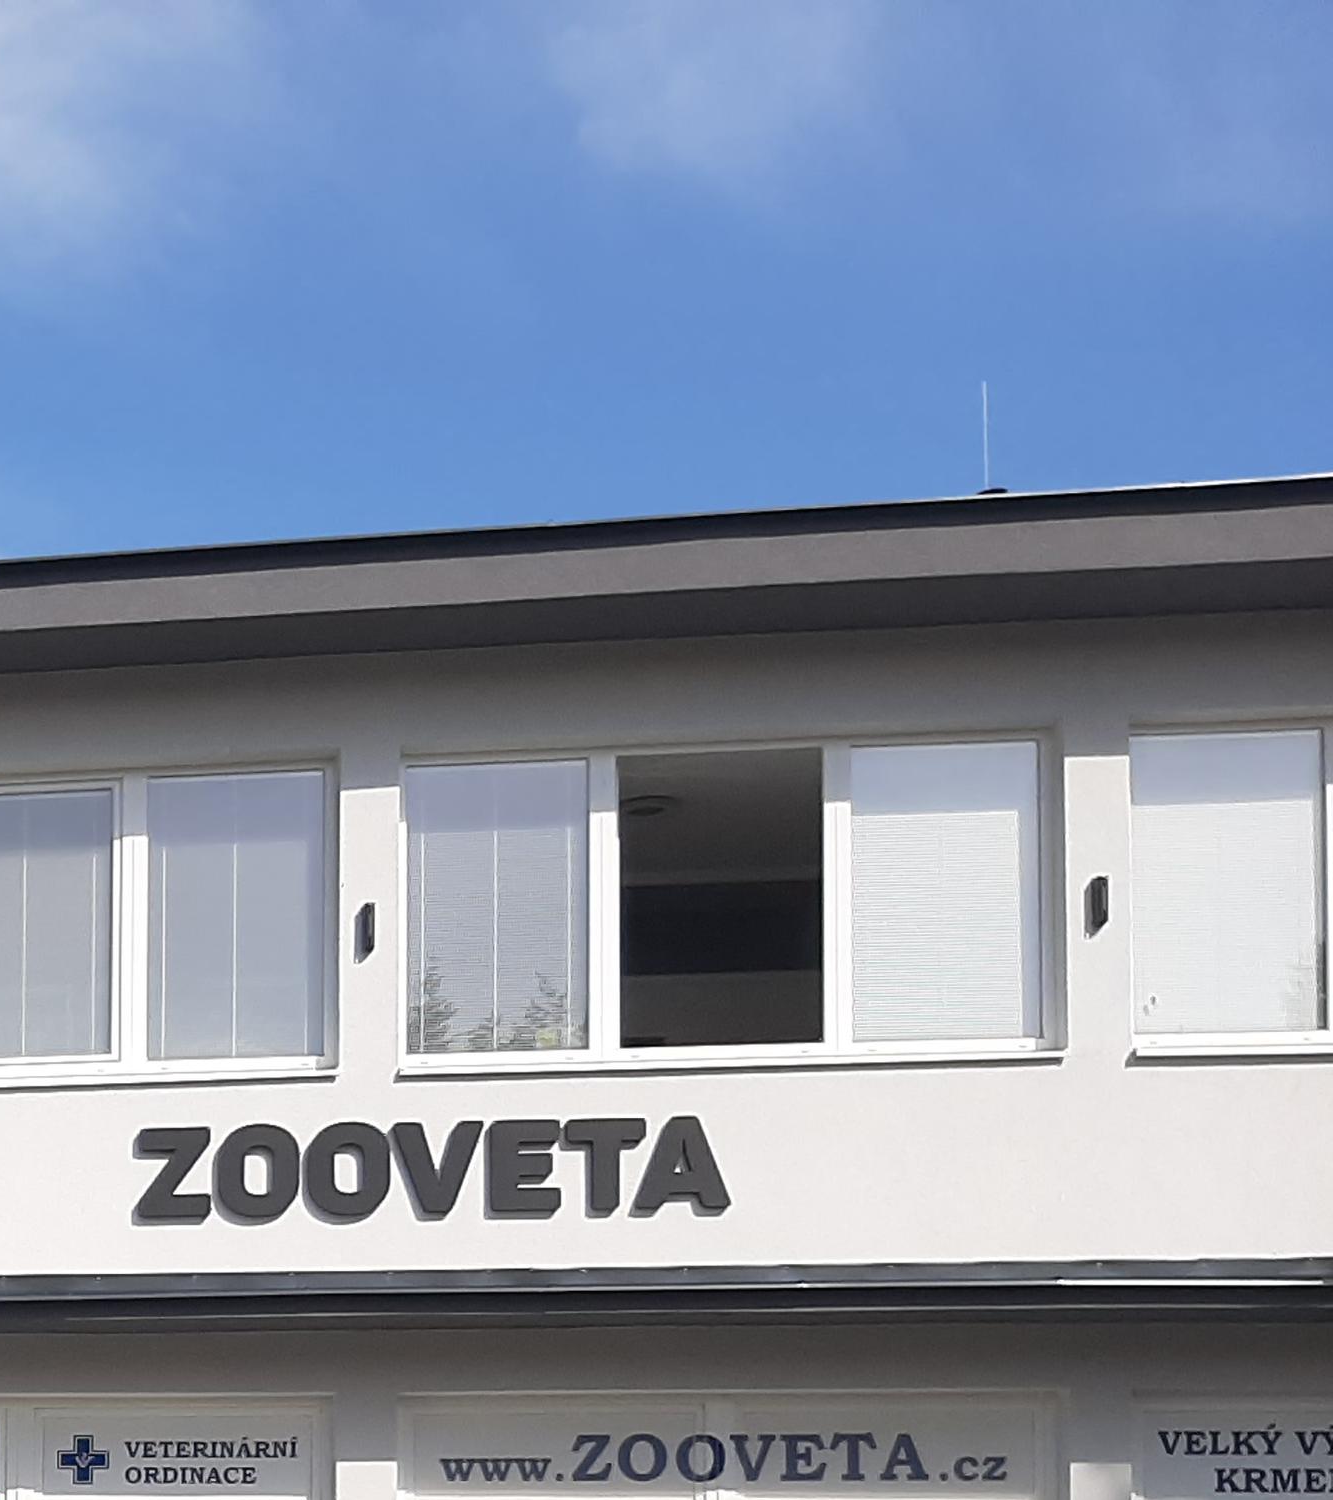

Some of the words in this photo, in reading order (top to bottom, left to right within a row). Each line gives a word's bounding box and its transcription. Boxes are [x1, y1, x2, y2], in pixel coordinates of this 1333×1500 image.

[132, 1115, 732, 1226] ZOOVETA
[124, 1436, 300, 1459] VETERINÁRNÍ
[1157, 1422, 1283, 1456] VELKÝ
[438, 1432, 1009, 1483] www.ZOOVETA.cz
[124, 1465, 258, 1486] ORDINACE
[1213, 1467, 1333, 1493] KRME
